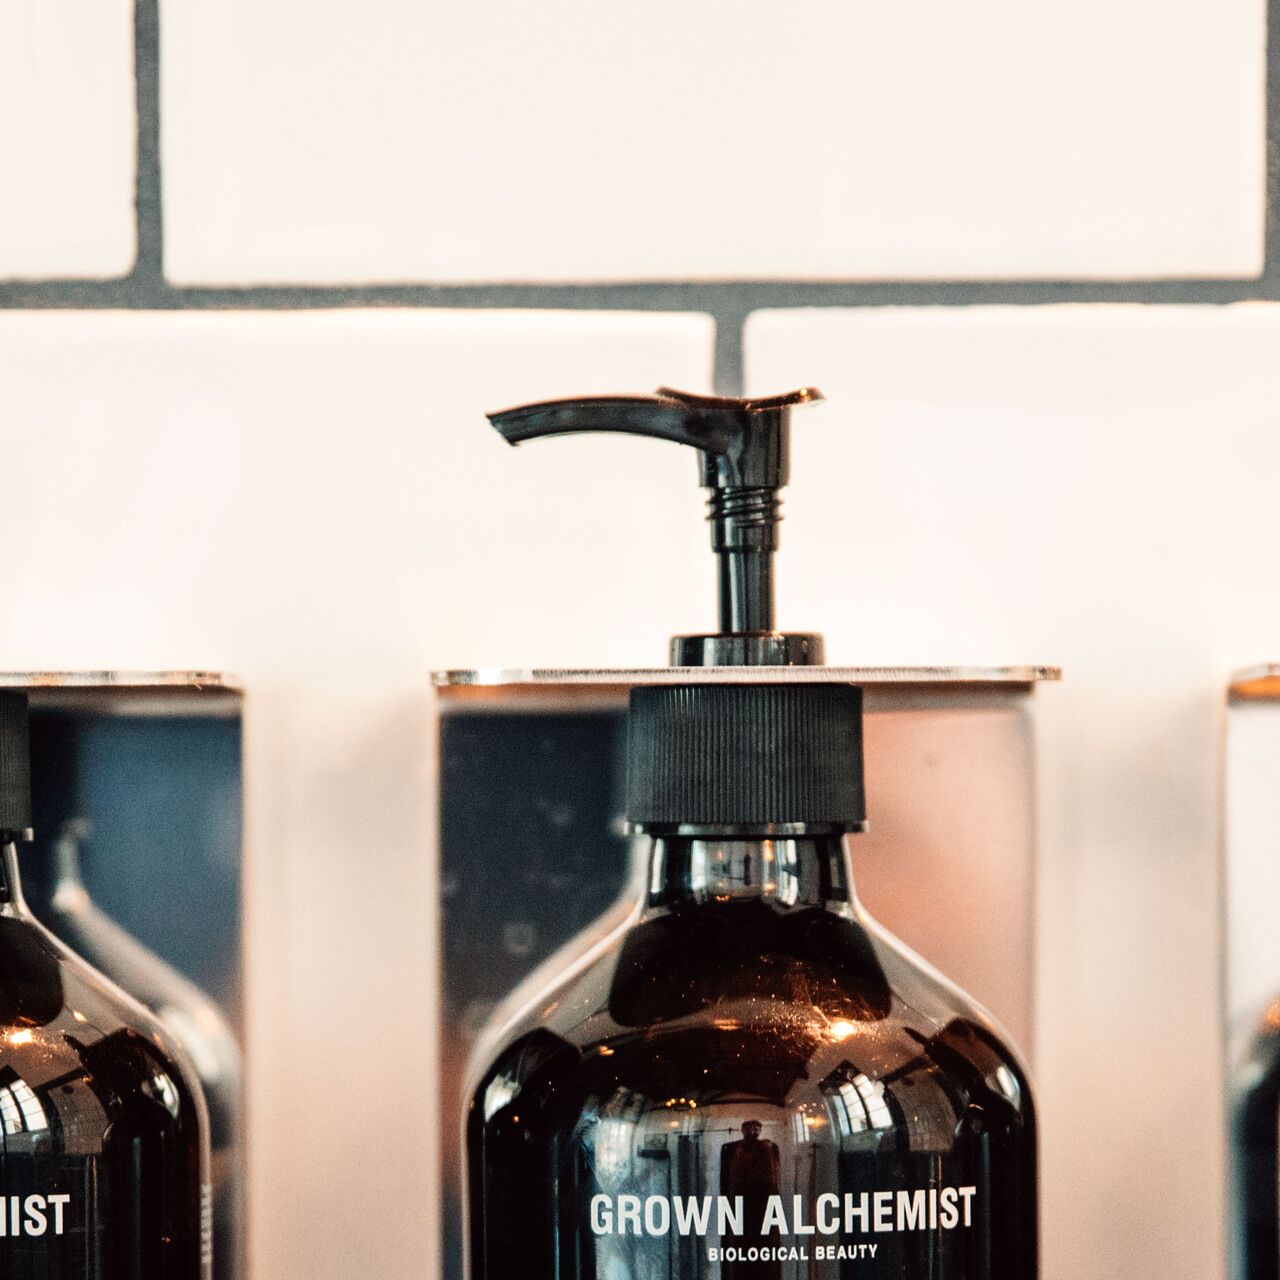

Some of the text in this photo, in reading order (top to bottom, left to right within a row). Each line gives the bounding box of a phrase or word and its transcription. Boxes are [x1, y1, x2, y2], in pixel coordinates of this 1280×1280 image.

[590, 1186, 977, 1236] GROWN ALCHEMIST
[708, 1244, 878, 1262] BIOLOGICAL BEAUTY
